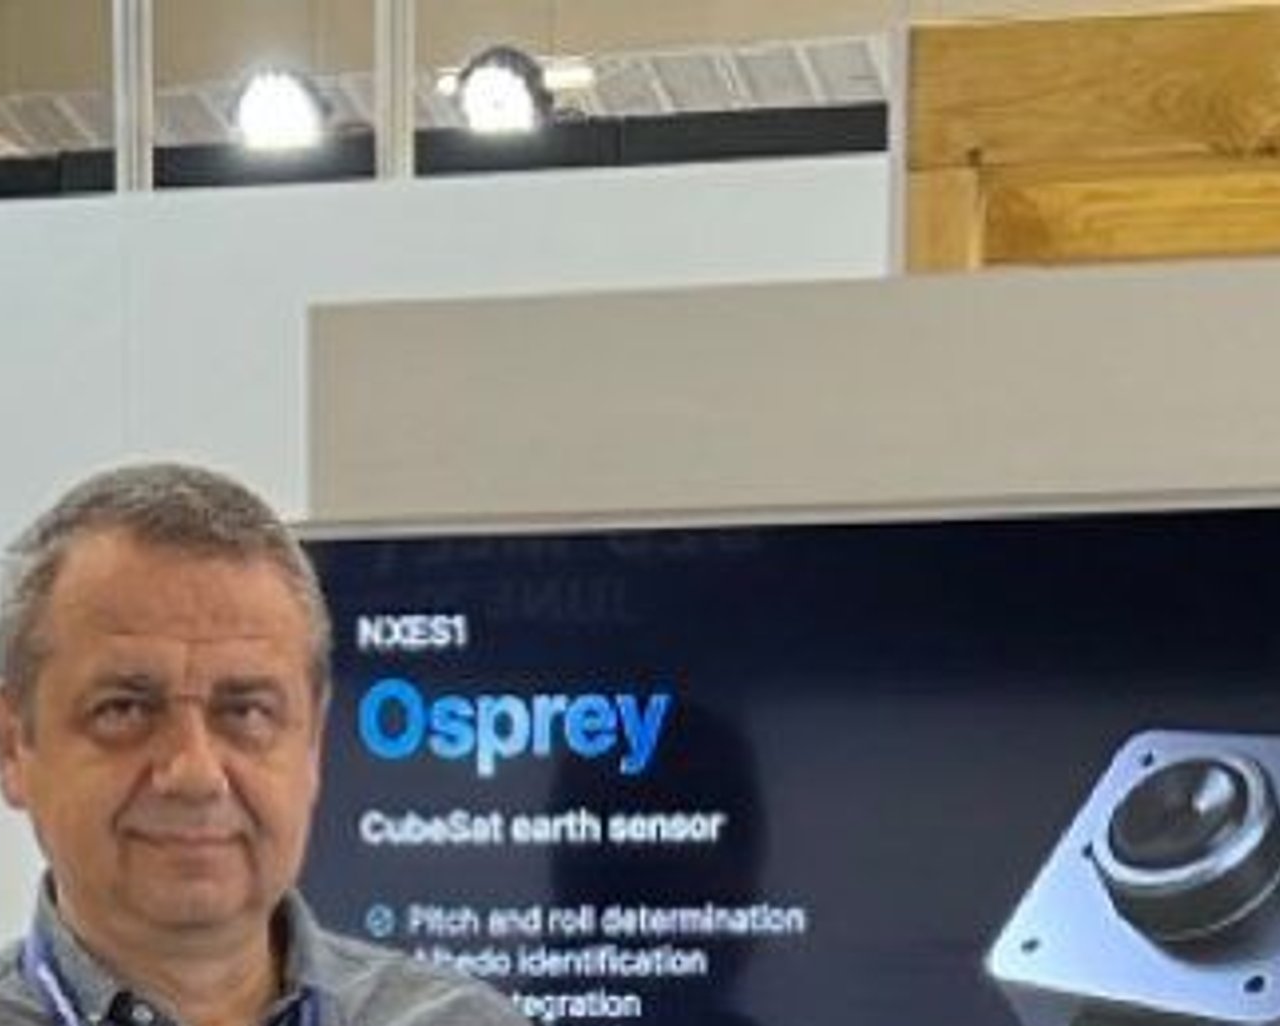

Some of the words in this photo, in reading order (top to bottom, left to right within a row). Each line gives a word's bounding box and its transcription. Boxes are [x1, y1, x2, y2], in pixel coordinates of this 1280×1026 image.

[357, 614, 468, 650] NXES1
[357, 677, 672, 777] Osprey
[359, 809, 503, 845] CubeSat
[511, 808, 602, 843] earth
[608, 811, 727, 842] sensor
[410, 905, 479, 935] Pitch
[487, 904, 542, 934] and
[549, 904, 595, 934] roll
[601, 903, 806, 935] determination
[519, 945, 709, 976] identification
